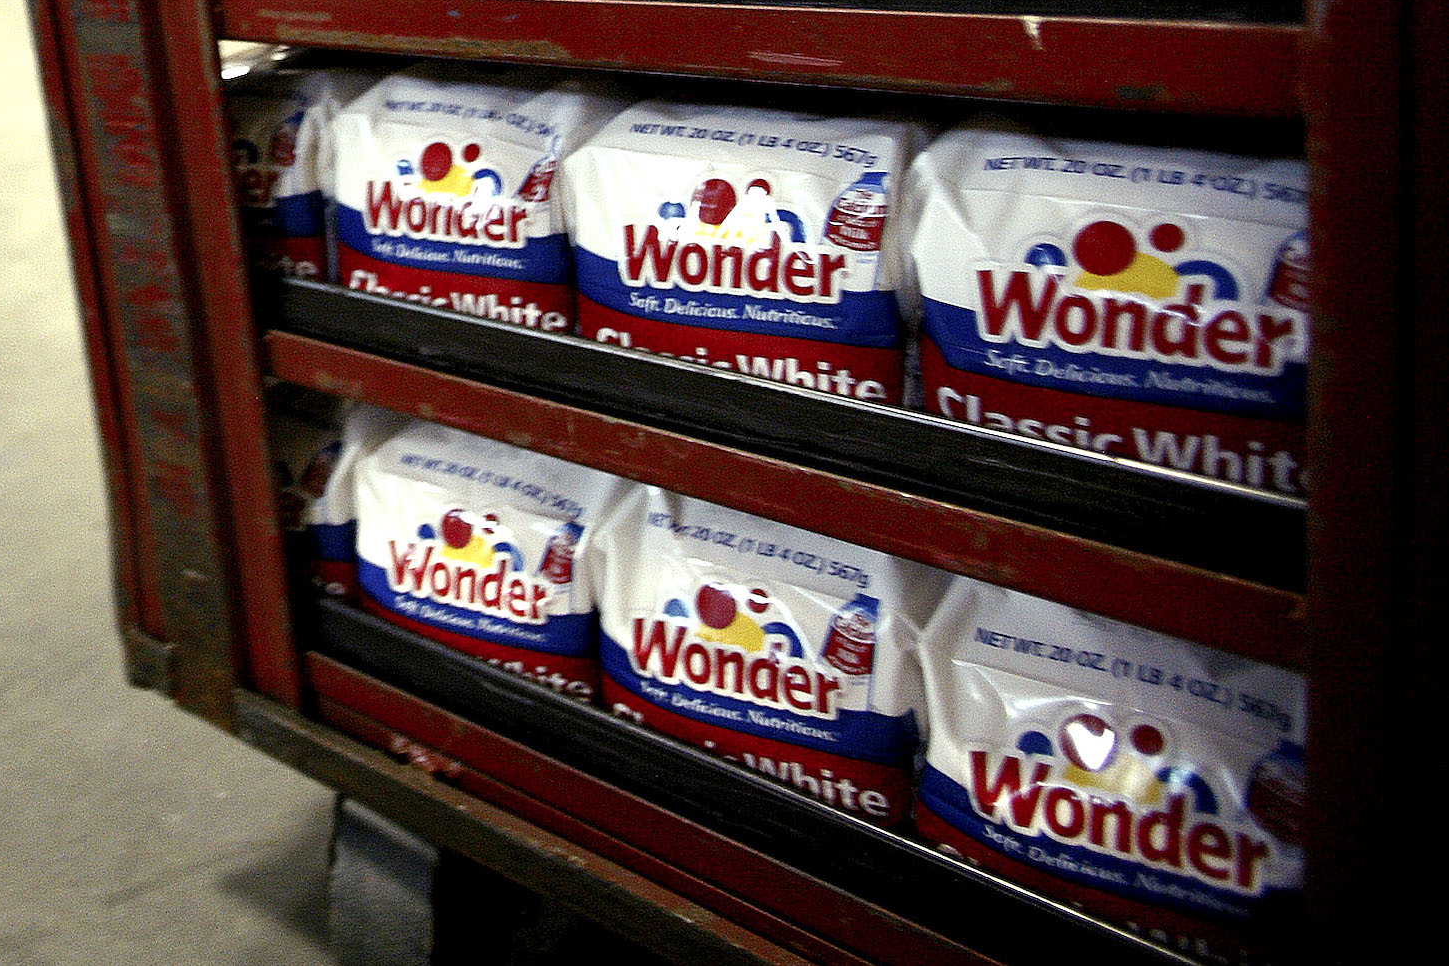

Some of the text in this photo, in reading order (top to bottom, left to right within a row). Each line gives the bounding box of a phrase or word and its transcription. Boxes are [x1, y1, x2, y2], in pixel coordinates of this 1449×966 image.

[368, 180, 526, 243] Wonder
[624, 224, 846, 297] Wonder
[452, 291, 568, 330] White
[976, 269, 1294, 368] Wonder
[736, 354, 887, 400] White
[1132, 427, 1308, 492] Whit
[388, 540, 551, 619] Wonder
[634, 618, 839, 714] Wonder
[743, 752, 891, 817] White
[970, 750, 1269, 888] Wonder
